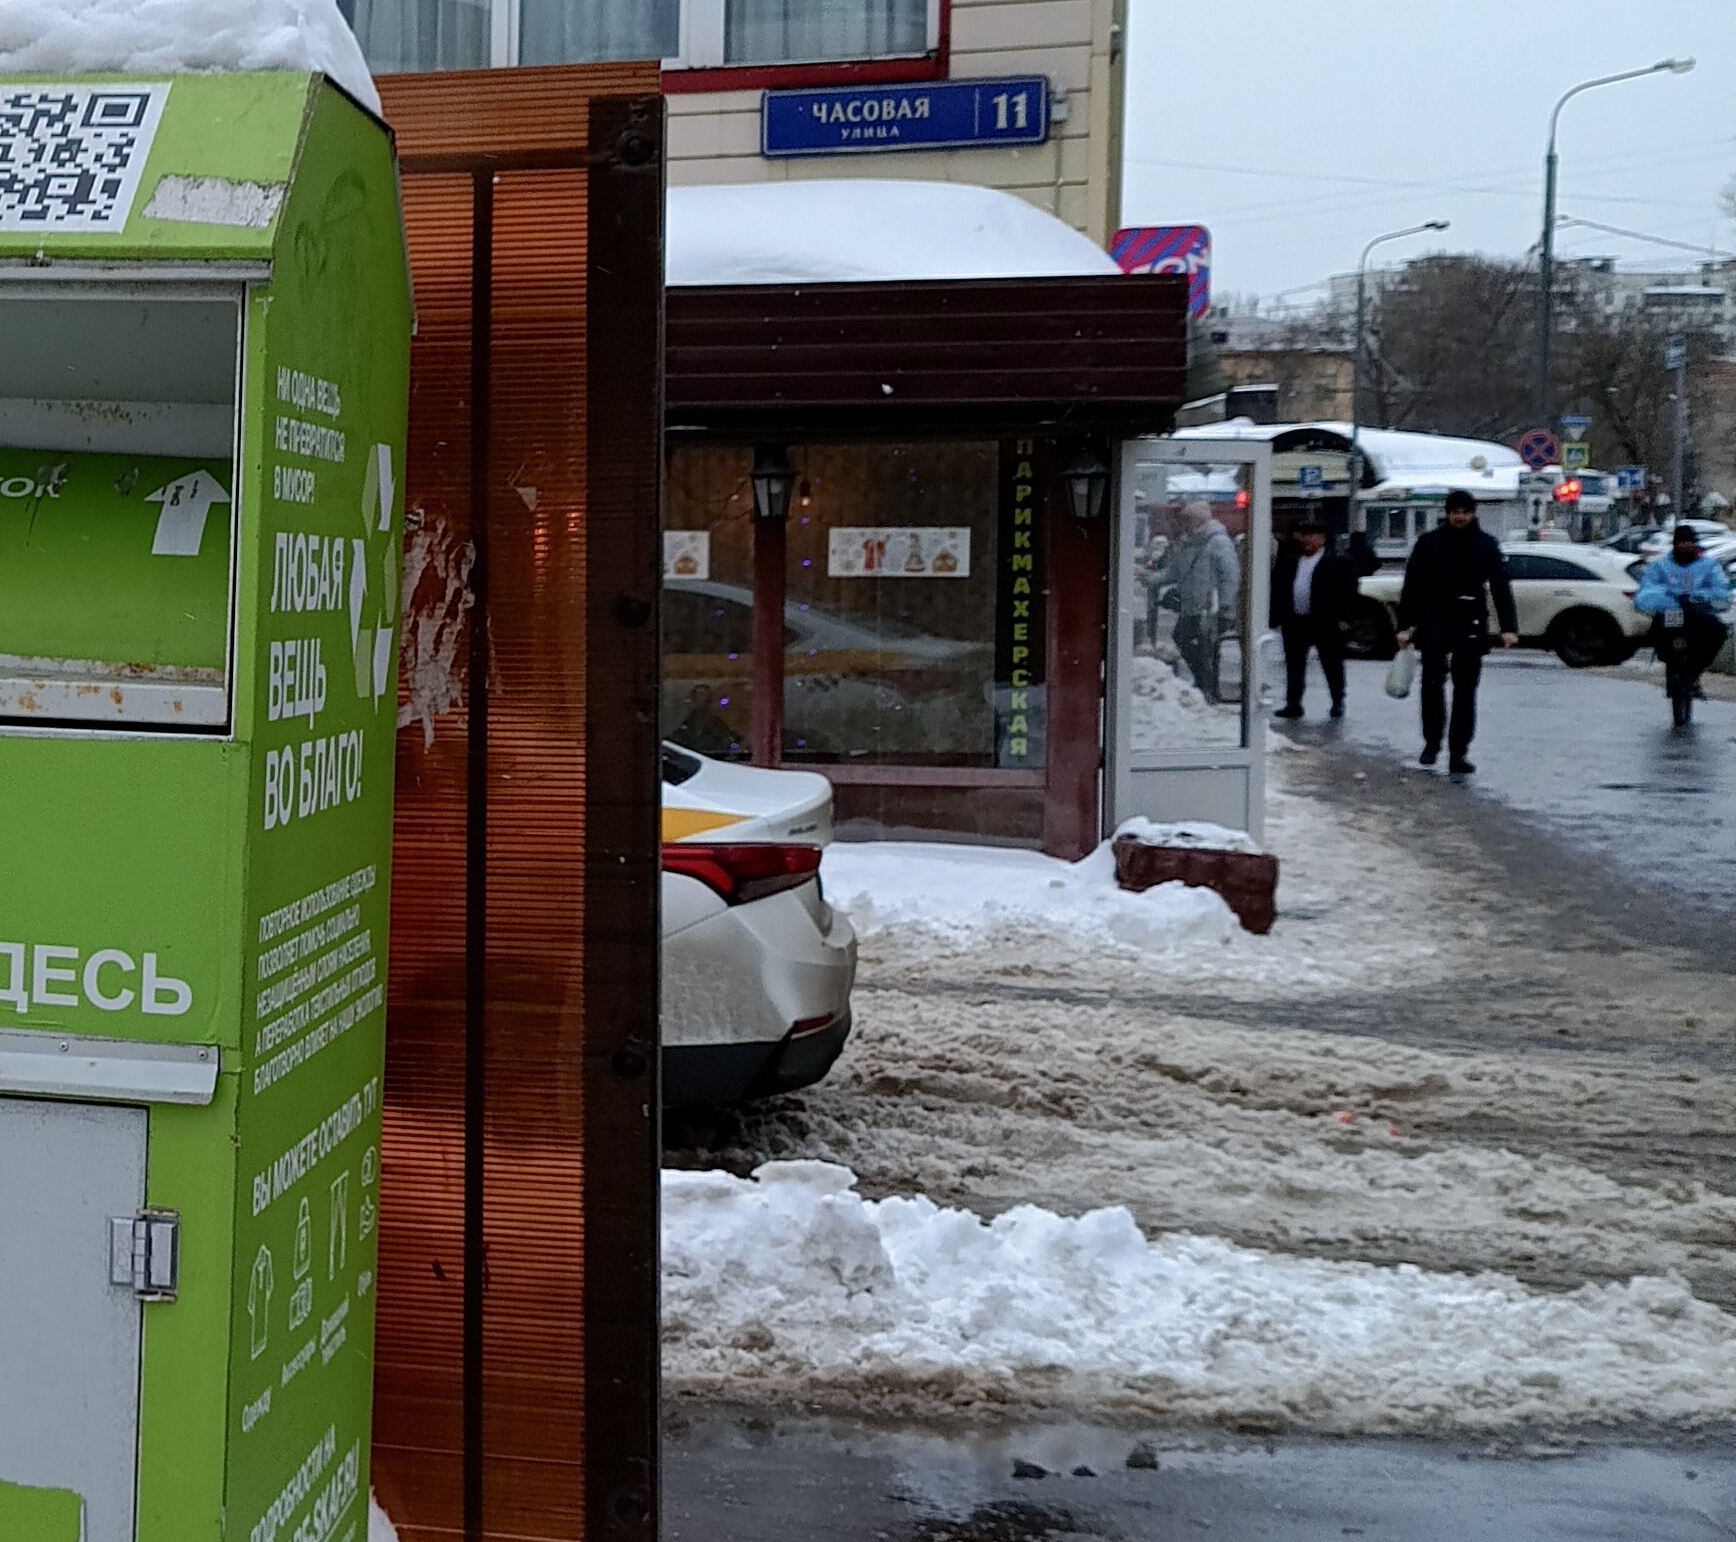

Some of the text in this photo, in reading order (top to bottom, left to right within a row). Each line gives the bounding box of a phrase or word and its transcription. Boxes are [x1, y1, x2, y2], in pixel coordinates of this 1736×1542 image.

[812, 92, 1028, 131] ЧАСОВАЯ 11
[270, 532, 345, 614] ЛЮБАЯ
[1008, 439, 1034, 757] ПАРИКМАХЕРСКАЯ
[267, 637, 327, 731] ВЕЩЬ
[264, 728, 364, 832] ВО БЛАГО!
